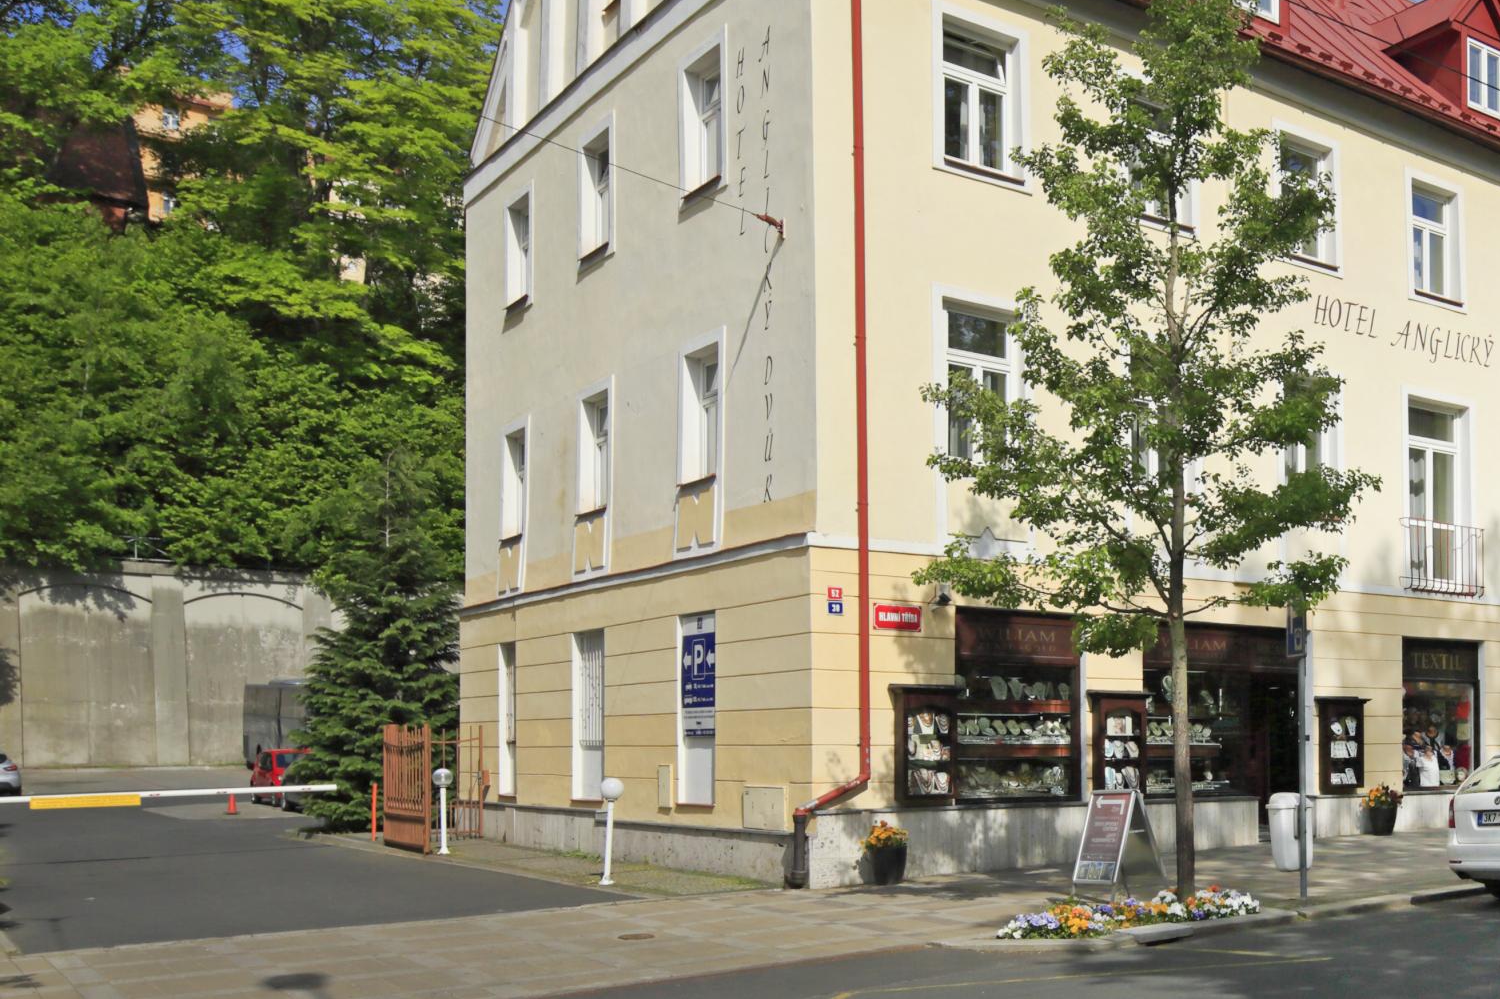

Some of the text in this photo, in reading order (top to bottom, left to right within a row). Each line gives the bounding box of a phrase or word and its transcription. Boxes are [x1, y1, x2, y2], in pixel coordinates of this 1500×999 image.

[735, 46, 747, 236] HOTEL
[1313, 293, 1378, 339] HOTEL
[1390, 319, 1495, 368] ANGLICKÝ
[878, 611, 900, 622] HLAVNÍ
[694, 644, 704, 676] P
[1411, 651, 1463, 671] TEXTIL
[1484, 812, 1497, 823] 3K7
